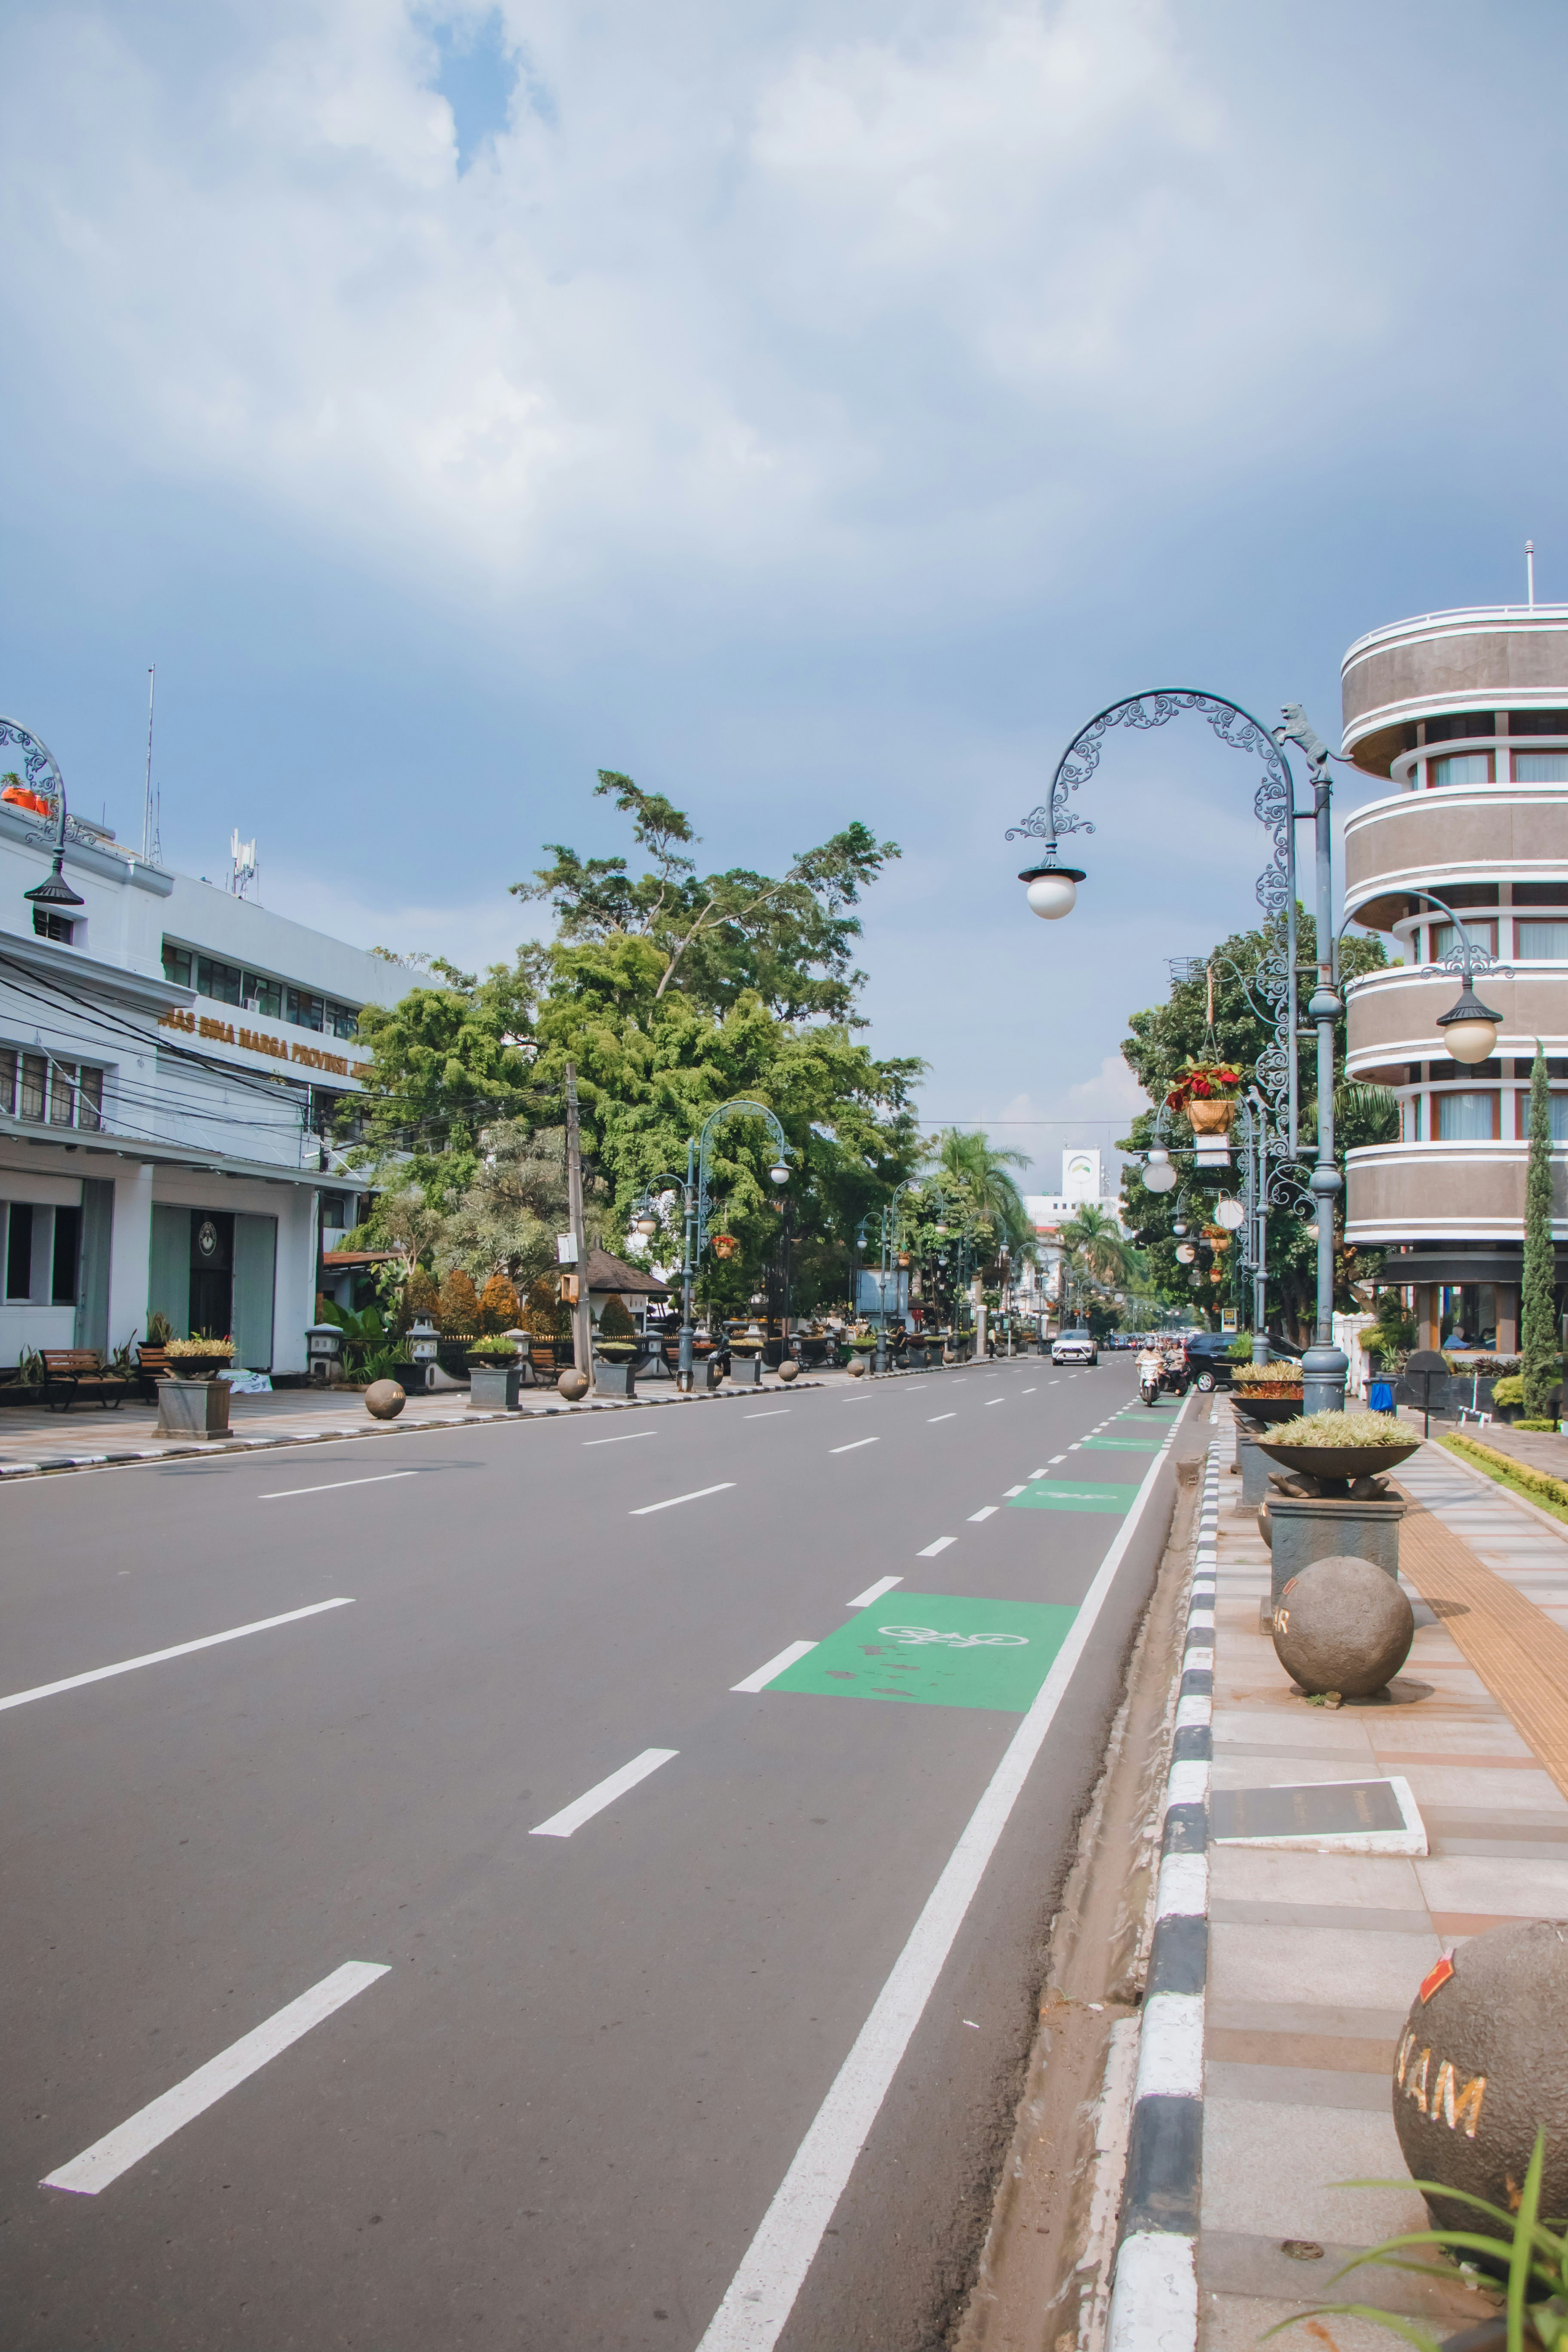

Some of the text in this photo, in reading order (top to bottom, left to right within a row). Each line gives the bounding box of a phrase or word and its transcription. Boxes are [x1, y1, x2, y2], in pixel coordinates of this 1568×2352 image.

[199, 1016, 235, 1045] BINA
[239, 1027, 288, 1060] MARGA
[292, 1042, 348, 1076] PROVINSI
